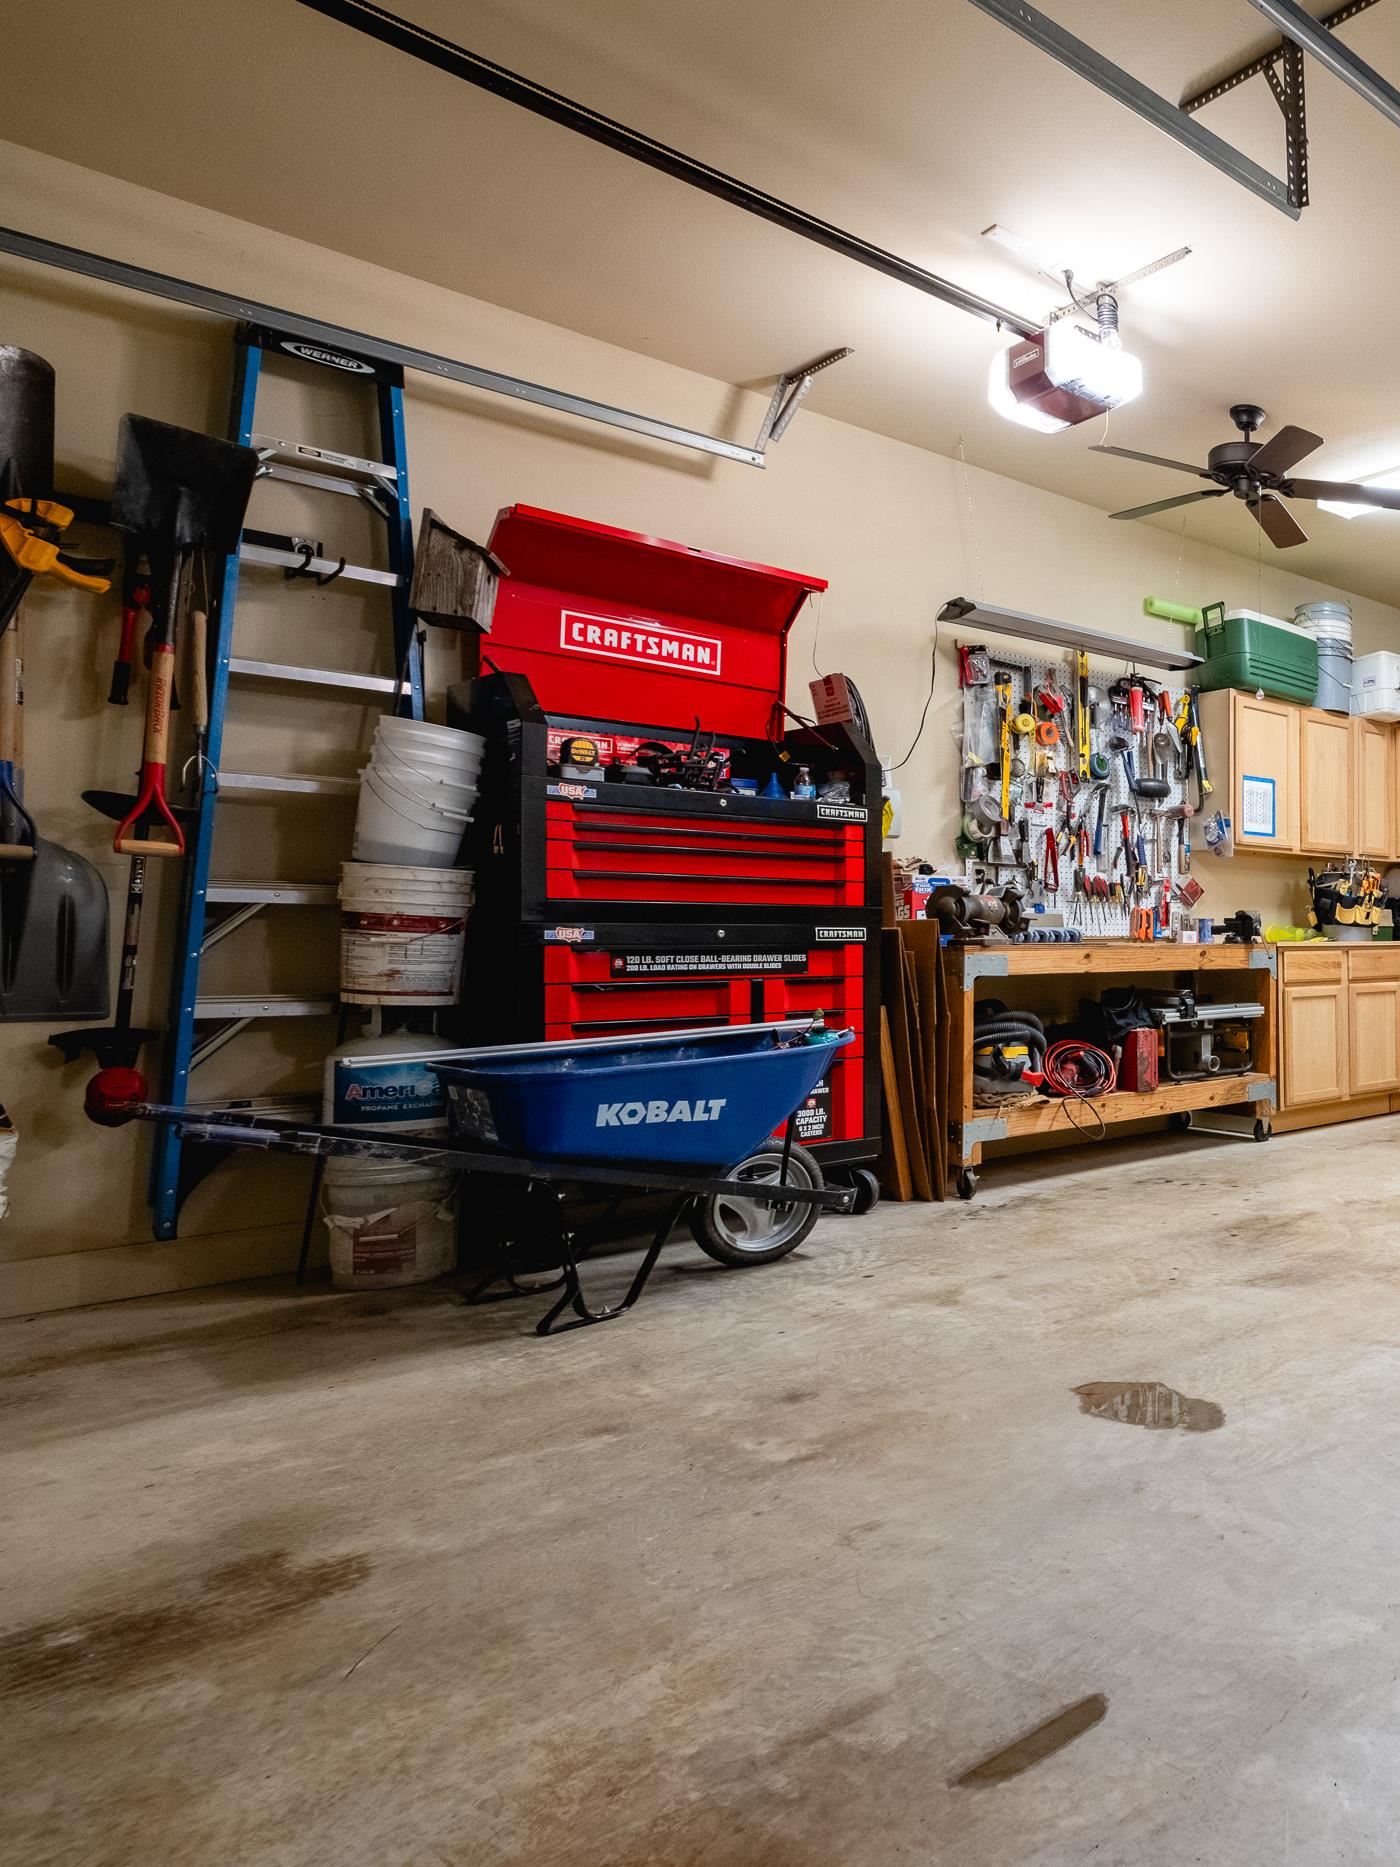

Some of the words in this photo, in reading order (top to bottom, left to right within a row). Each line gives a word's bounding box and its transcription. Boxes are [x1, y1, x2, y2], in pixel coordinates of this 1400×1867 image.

[300, 346, 358, 369] WERNER
[572, 622, 711, 665] CRAFTSMAN
[561, 785, 583, 796] USA
[820, 808, 865, 819] CRAFTSMAN
[559, 930, 580, 939] USA
[819, 930, 863, 938] CRAFTSMAN
[626, 955, 640, 964] 120
[641, 955, 654, 963] LB.
[655, 955, 675, 963] SOFT
[675, 955, 699, 963] CLOSE
[700, 954, 752, 963] BALL-BEARING
[753, 954, 782, 962] DRAWER
[783, 954, 807, 962] SLIDES
[344, 1080, 441, 1100] AmeriGa
[361, 1104, 399, 1112] PROPANE
[595, 1099, 727, 1127] KOBALT
[796, 1115, 827, 1125] CAPACITY
